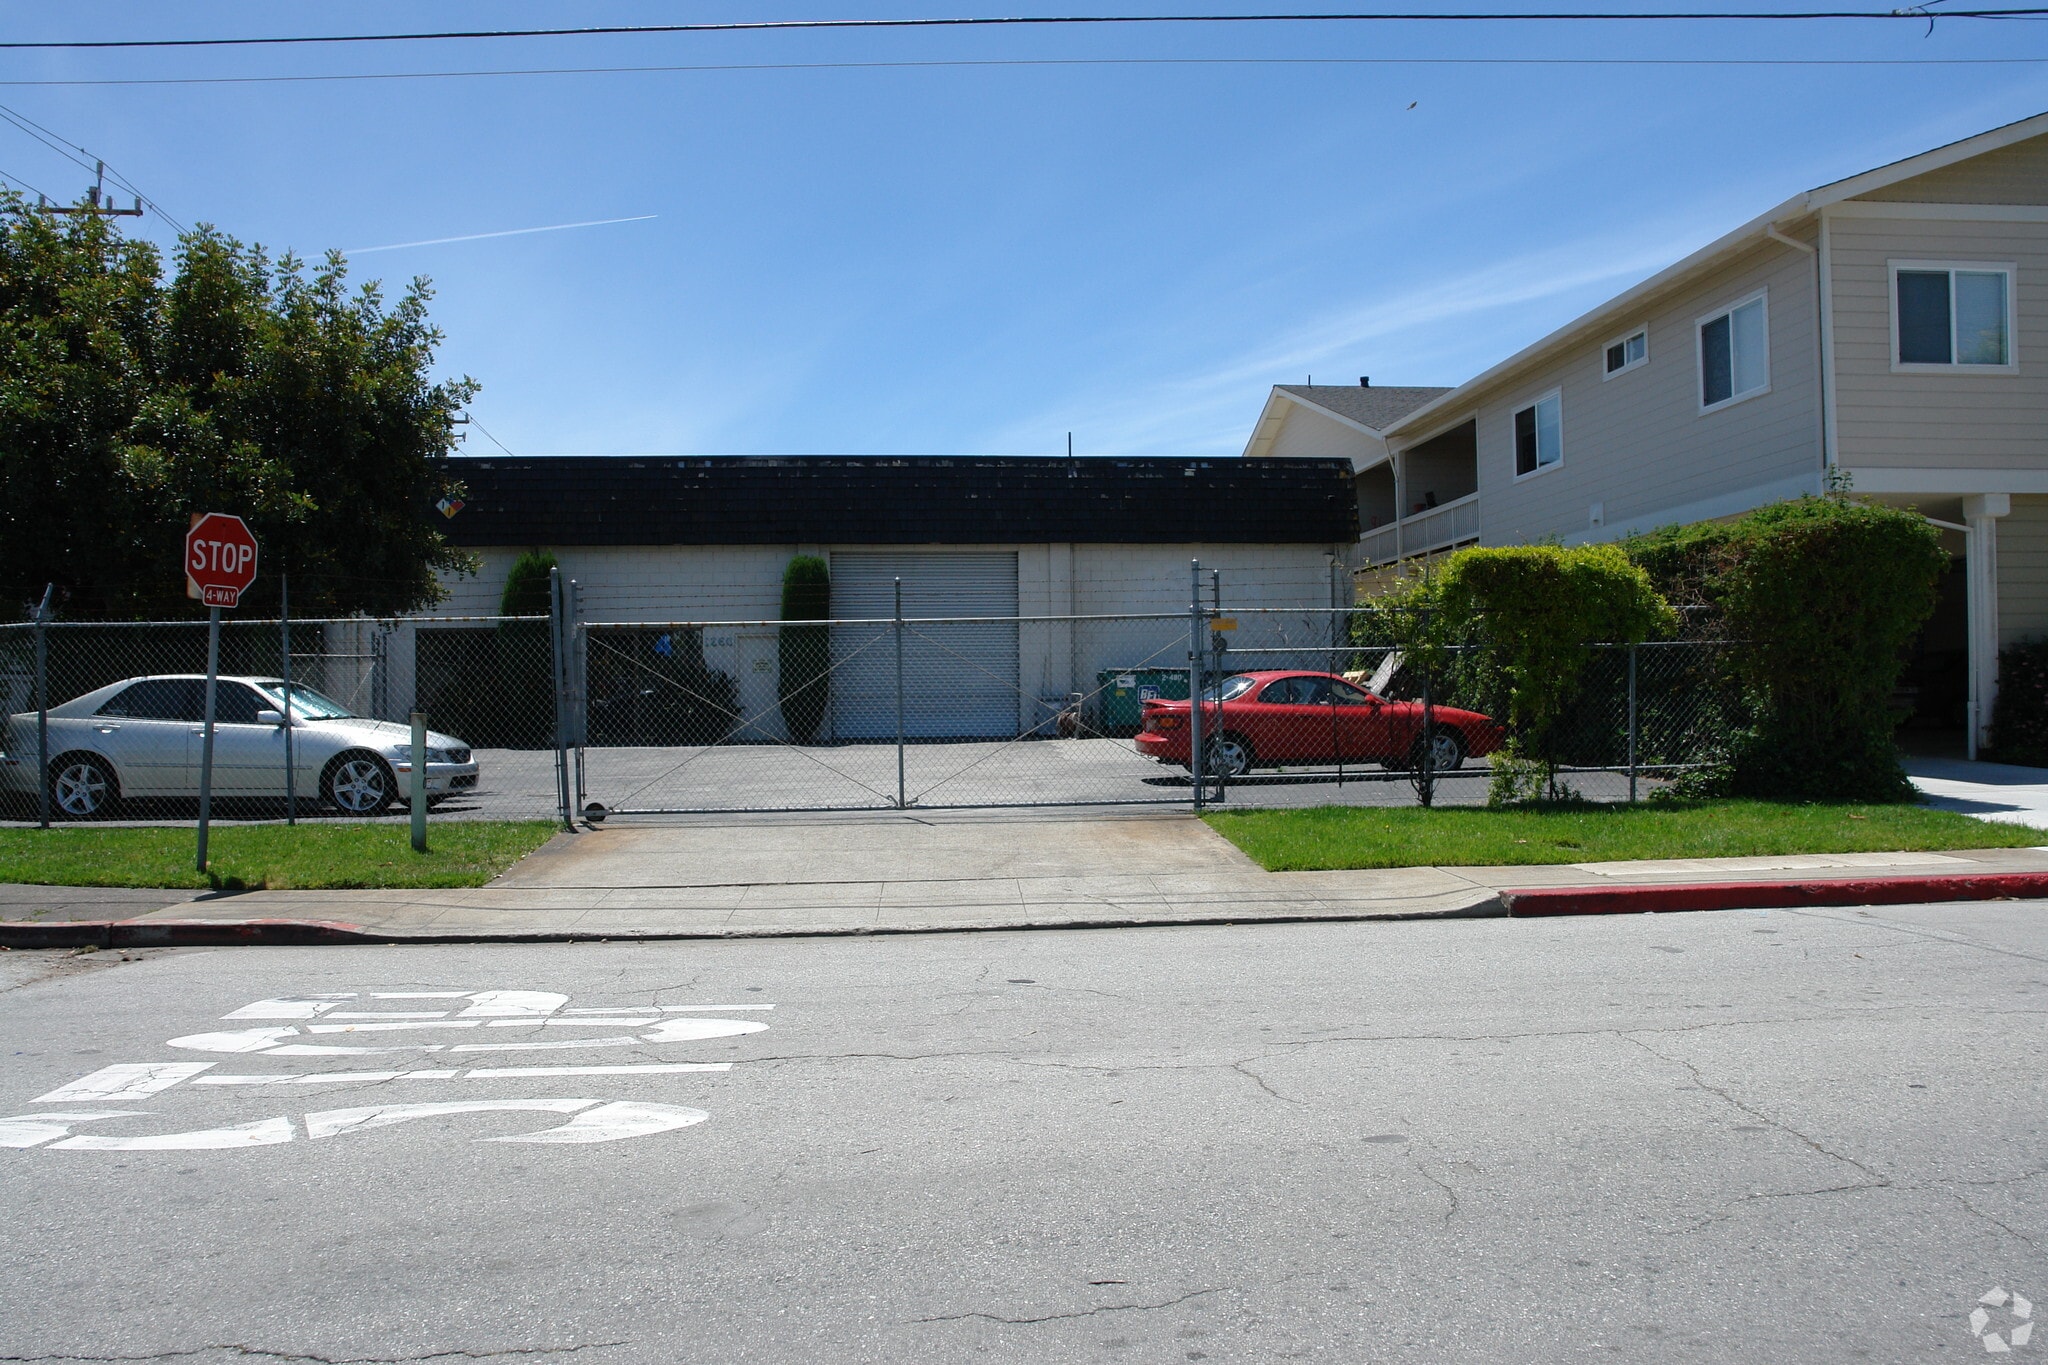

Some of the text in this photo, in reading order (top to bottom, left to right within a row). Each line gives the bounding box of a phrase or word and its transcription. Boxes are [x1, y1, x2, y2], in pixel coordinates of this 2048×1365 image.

[192, 539, 253, 574] STOP
[206, 589, 236, 603] 4-WAY
[0, 990, 777, 1150] STOP
